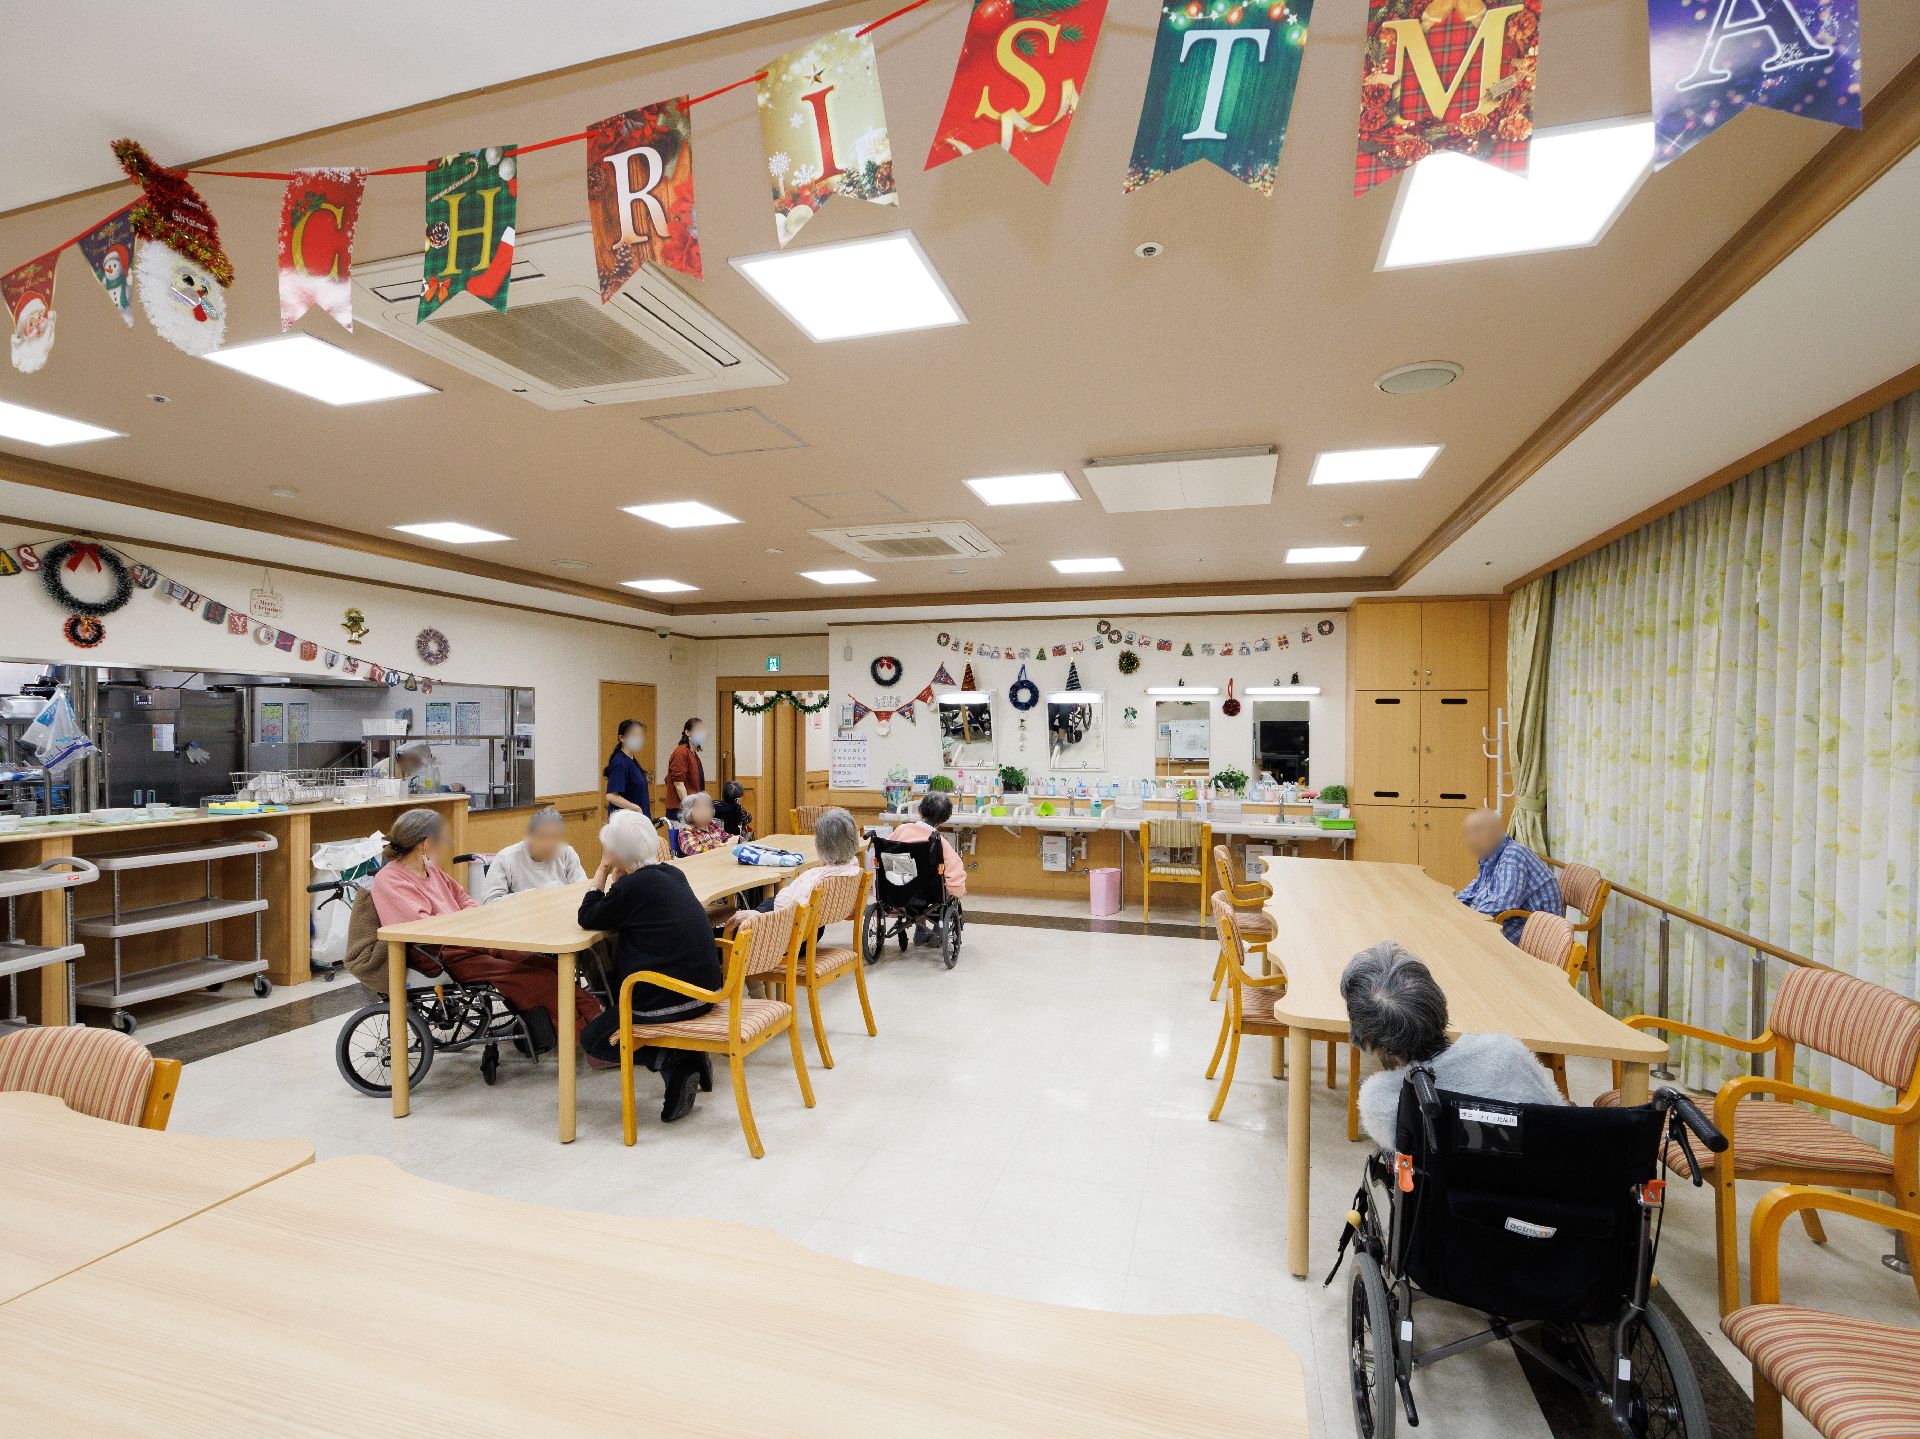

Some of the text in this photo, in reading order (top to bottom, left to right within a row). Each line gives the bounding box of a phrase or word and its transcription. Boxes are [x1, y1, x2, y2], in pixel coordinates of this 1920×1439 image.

[291, 0, 1836, 282] C H R I S T M A
[19, 546, 40, 571] S
